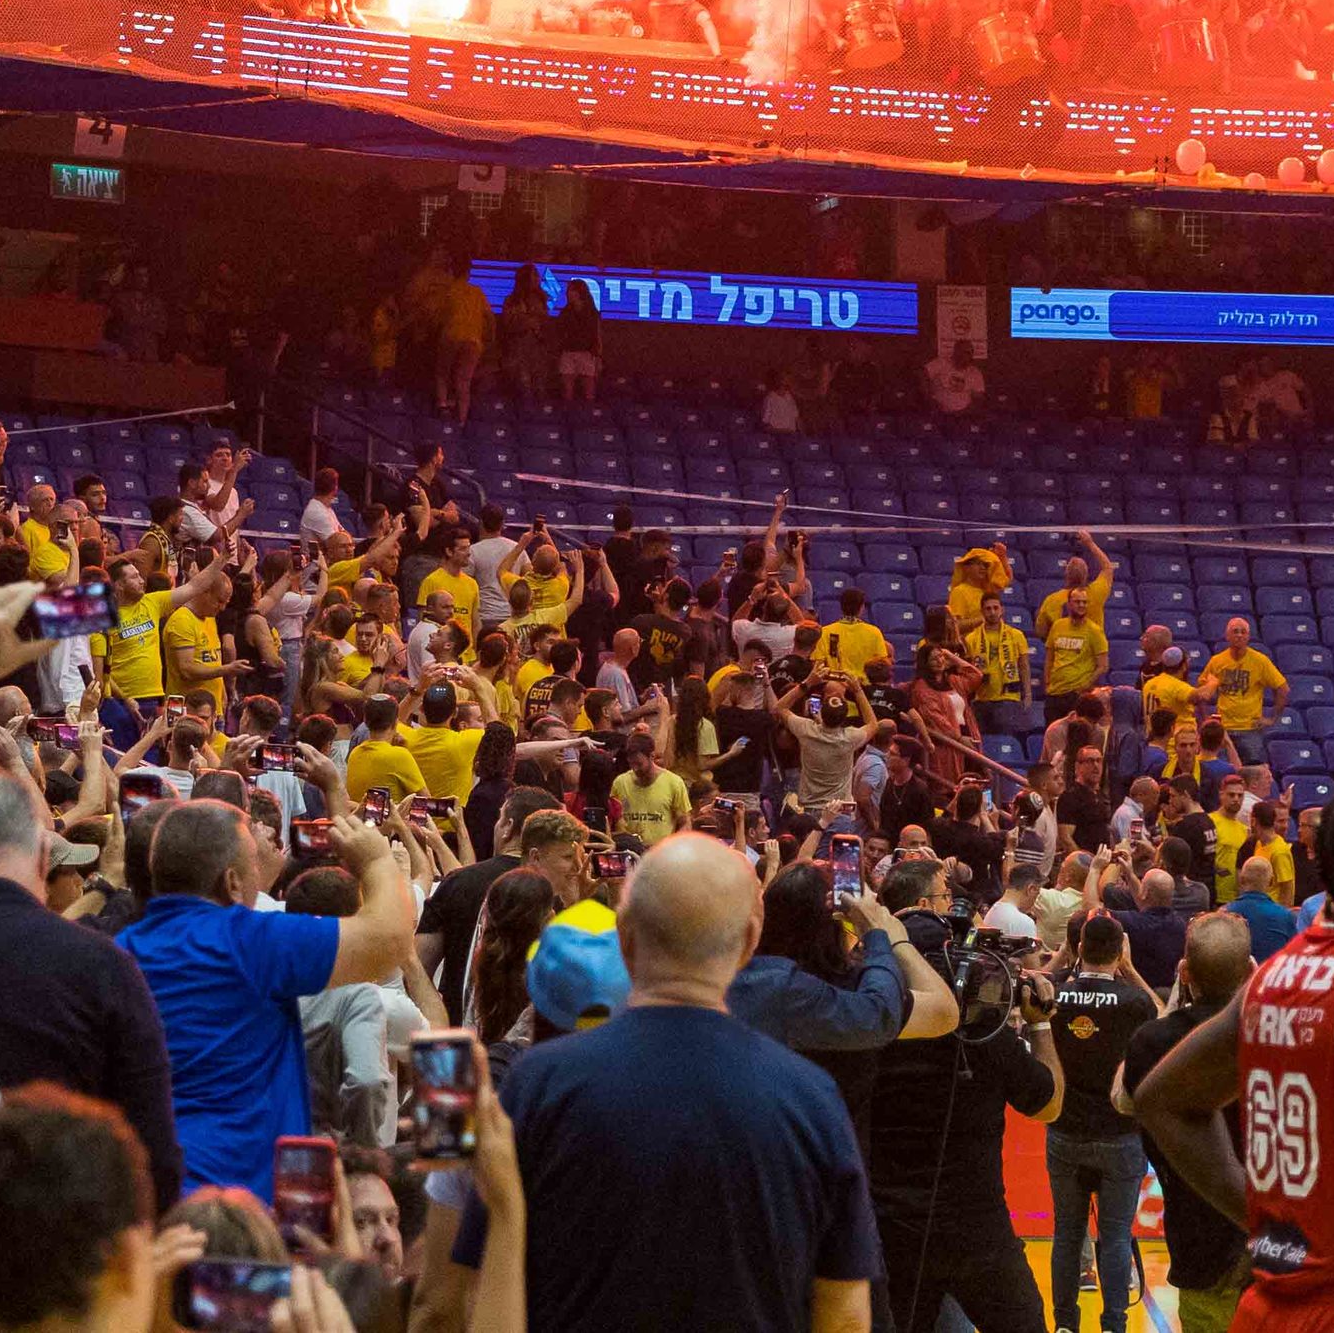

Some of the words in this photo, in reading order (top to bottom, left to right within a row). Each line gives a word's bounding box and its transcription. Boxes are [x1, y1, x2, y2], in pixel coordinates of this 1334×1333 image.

[709, 275, 860, 329] טריפל
[1217, 309, 1266, 326] בקליק
[1268, 310, 1318, 328] תדלוק
[1057, 990, 1118, 1009] תקשורת
[1245, 1068, 1319, 1198] 69
